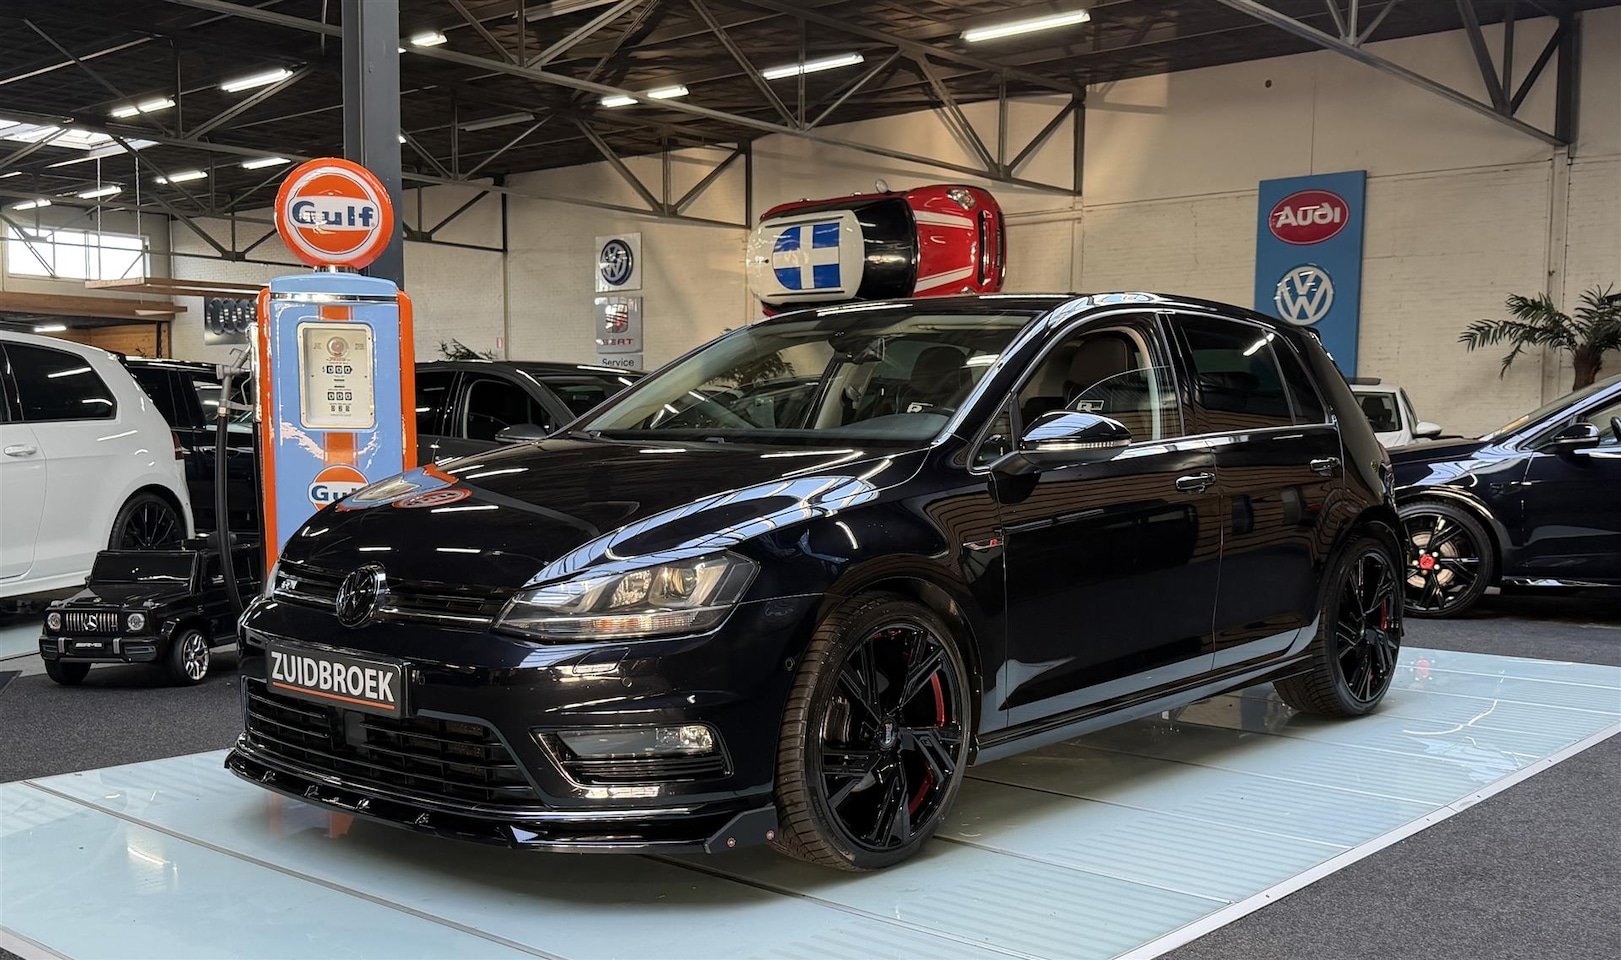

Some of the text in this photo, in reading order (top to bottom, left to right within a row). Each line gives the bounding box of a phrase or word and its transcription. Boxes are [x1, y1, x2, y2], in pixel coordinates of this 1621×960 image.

[292, 200, 374, 227] Gulf
[602, 357, 635, 367] Service
[311, 485, 358, 501] Gu
[271, 651, 395, 702] ZUIDBROEK
